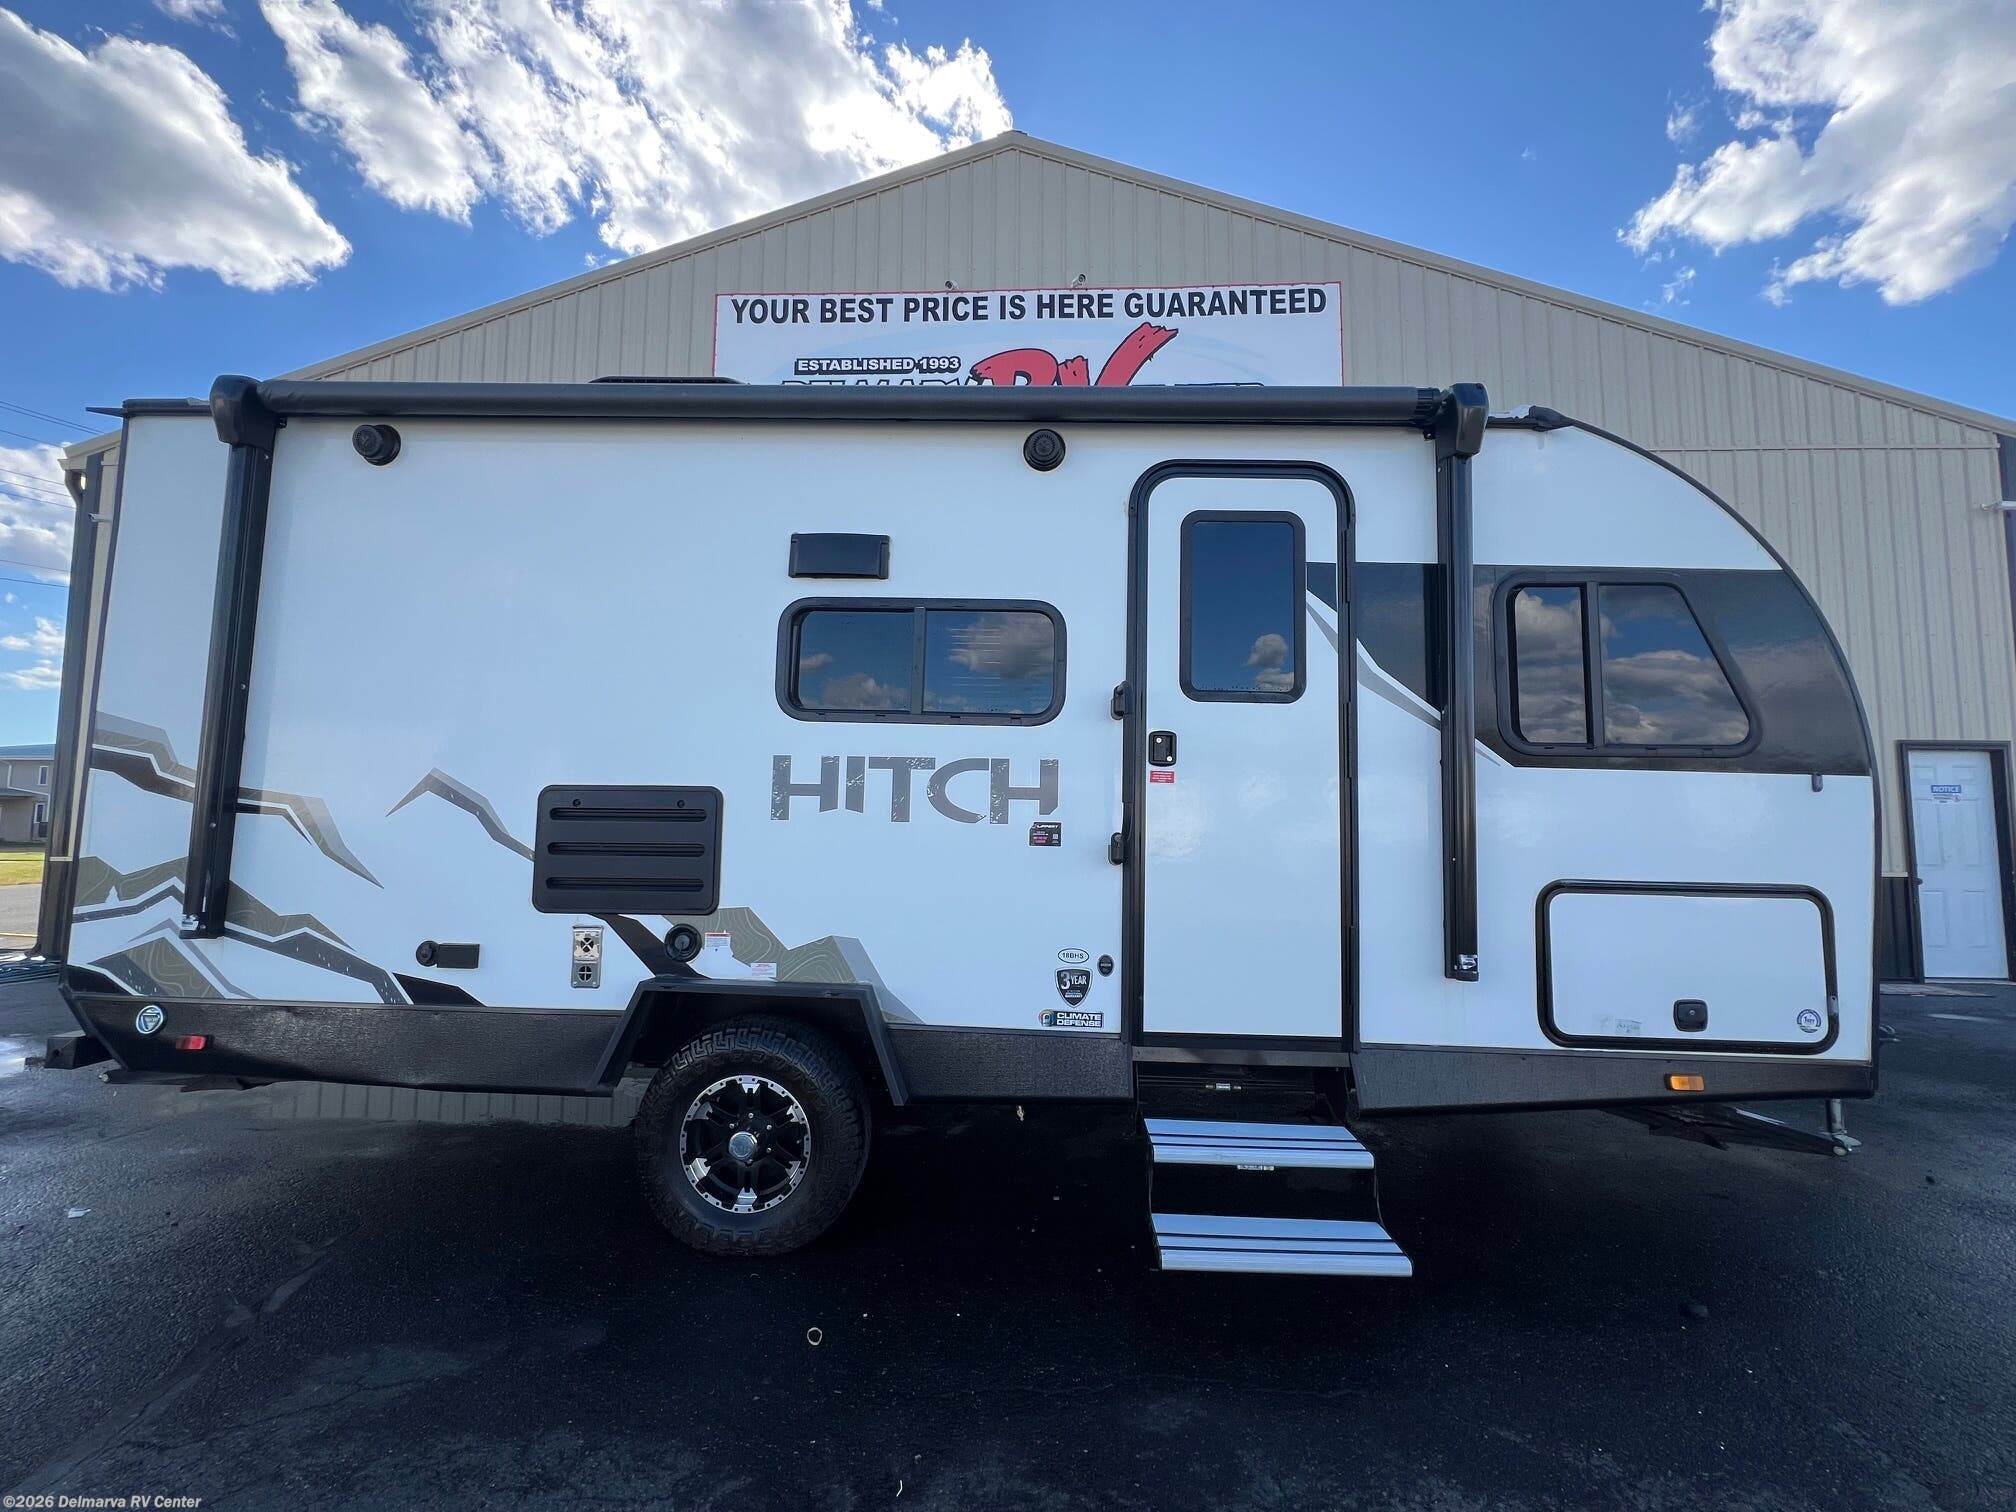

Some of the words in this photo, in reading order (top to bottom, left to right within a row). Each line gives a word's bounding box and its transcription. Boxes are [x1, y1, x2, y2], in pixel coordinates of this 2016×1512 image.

[731, 298, 810, 323] YOUR
[820, 298, 893, 323] BEST
[904, 296, 988, 322] PRICE
[1000, 294, 1026, 320] IS
[1036, 293, 1114, 319] HERE
[1124, 288, 1327, 318] GUARANTEED
[797, 358, 915, 371] ESTABLISHED
[919, 357, 960, 370] 1993
[770, 755, 1059, 824] HITCH
[1062, 952, 1084, 960] 18BHS
[1060, 971, 1071, 990] 3
[1071, 975, 1087, 985] YEAR
[1056, 1019, 1102, 1027] DEFENSE
[1057, 1012, 1102, 1020] CLIMATE
